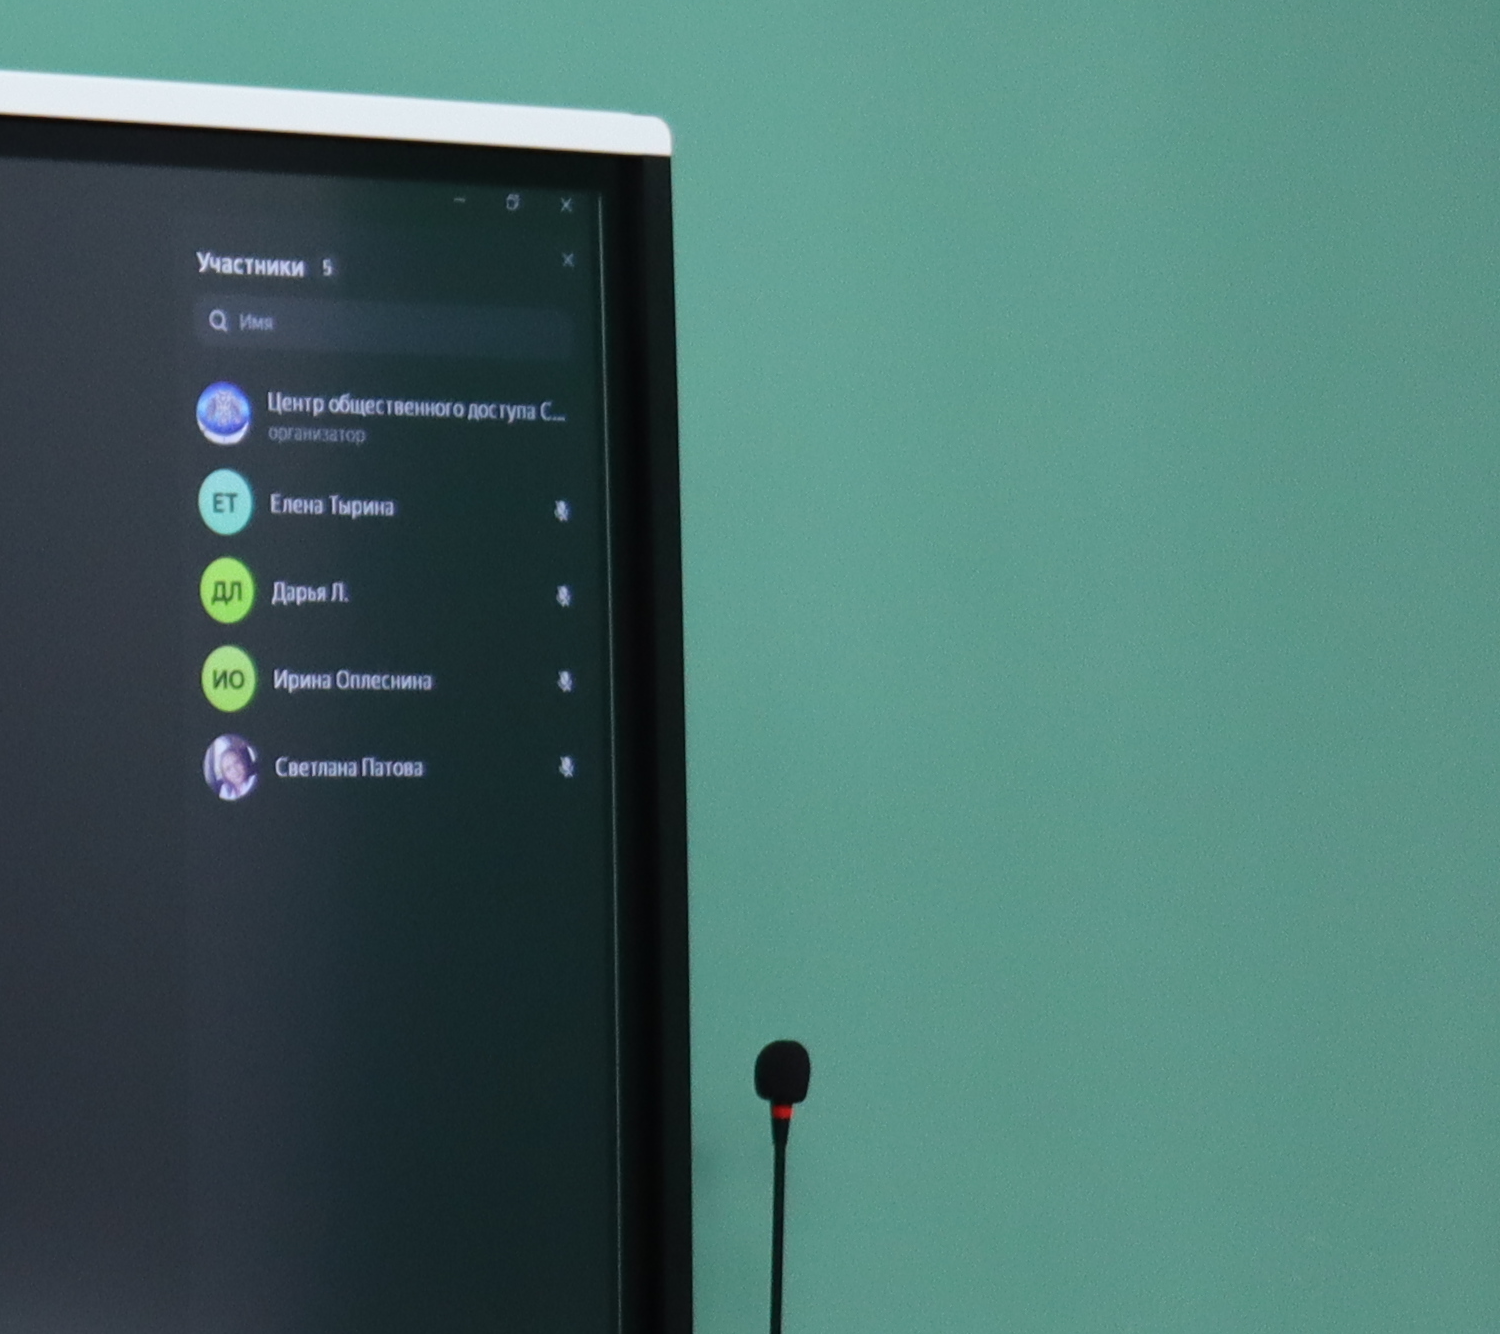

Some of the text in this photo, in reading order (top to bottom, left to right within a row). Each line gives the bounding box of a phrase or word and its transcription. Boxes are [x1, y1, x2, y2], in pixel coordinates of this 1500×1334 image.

[197, 252, 333, 279] Участники 5
[268, 391, 325, 417] Центр
[328, 395, 465, 420] общественного
[468, 401, 535, 423] доступа
[268, 425, 365, 446] организатор
[212, 493, 237, 513] ЕТ
[270, 495, 394, 521] Елена Тырина
[211, 582, 242, 605] ДЛ
[272, 582, 349, 606] Дарья Л.
[213, 669, 244, 690] ИО
[273, 669, 431, 694] Ирина Оплеснина
[275, 757, 423, 778] Светлана Патова
